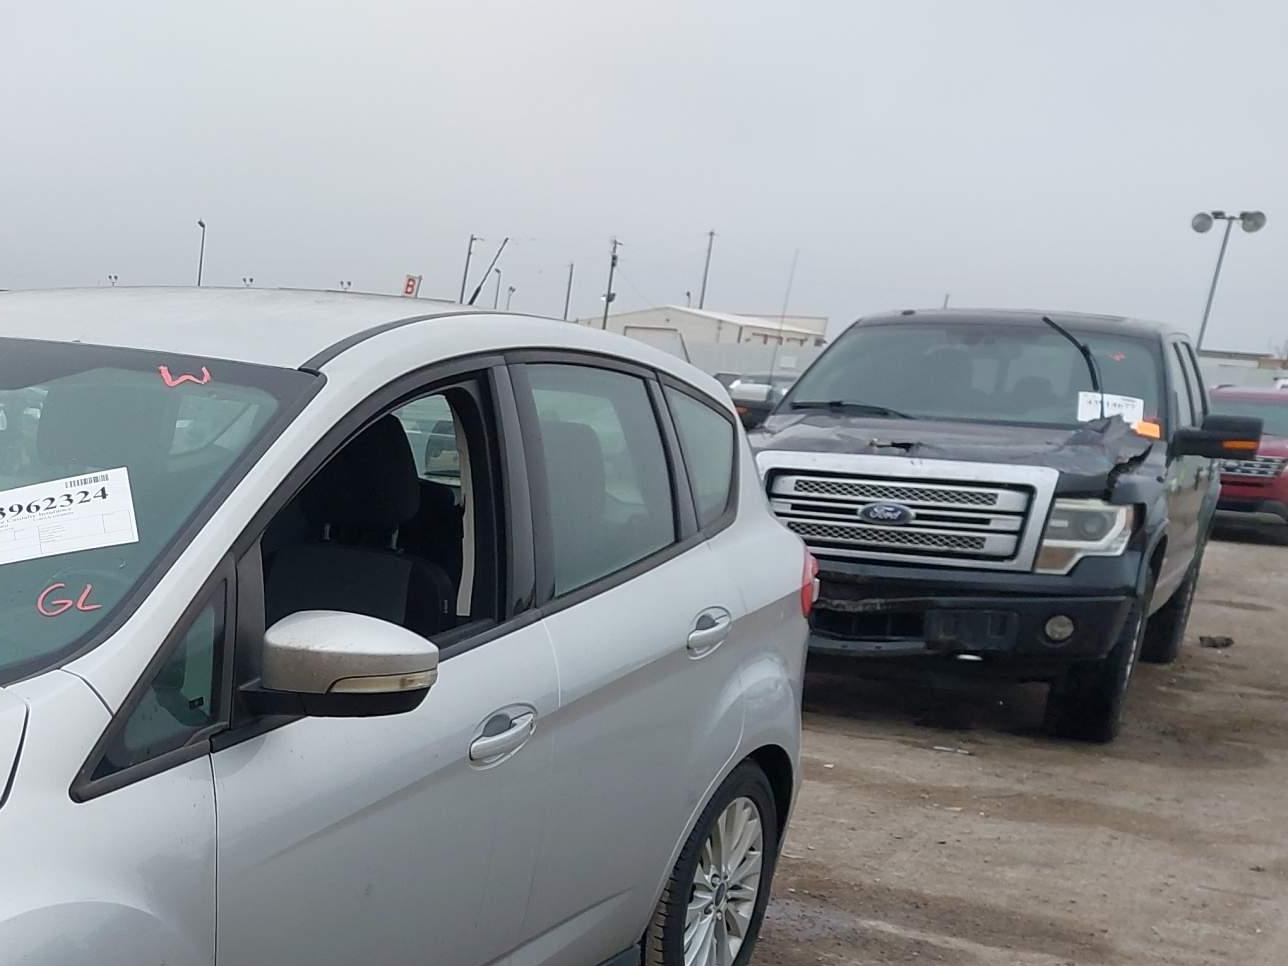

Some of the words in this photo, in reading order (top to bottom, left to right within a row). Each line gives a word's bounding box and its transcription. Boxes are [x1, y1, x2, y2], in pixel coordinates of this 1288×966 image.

[404, 278, 416, 295] B
[869, 507, 902, 520] Ford
[36, 583, 102, 617] GL
